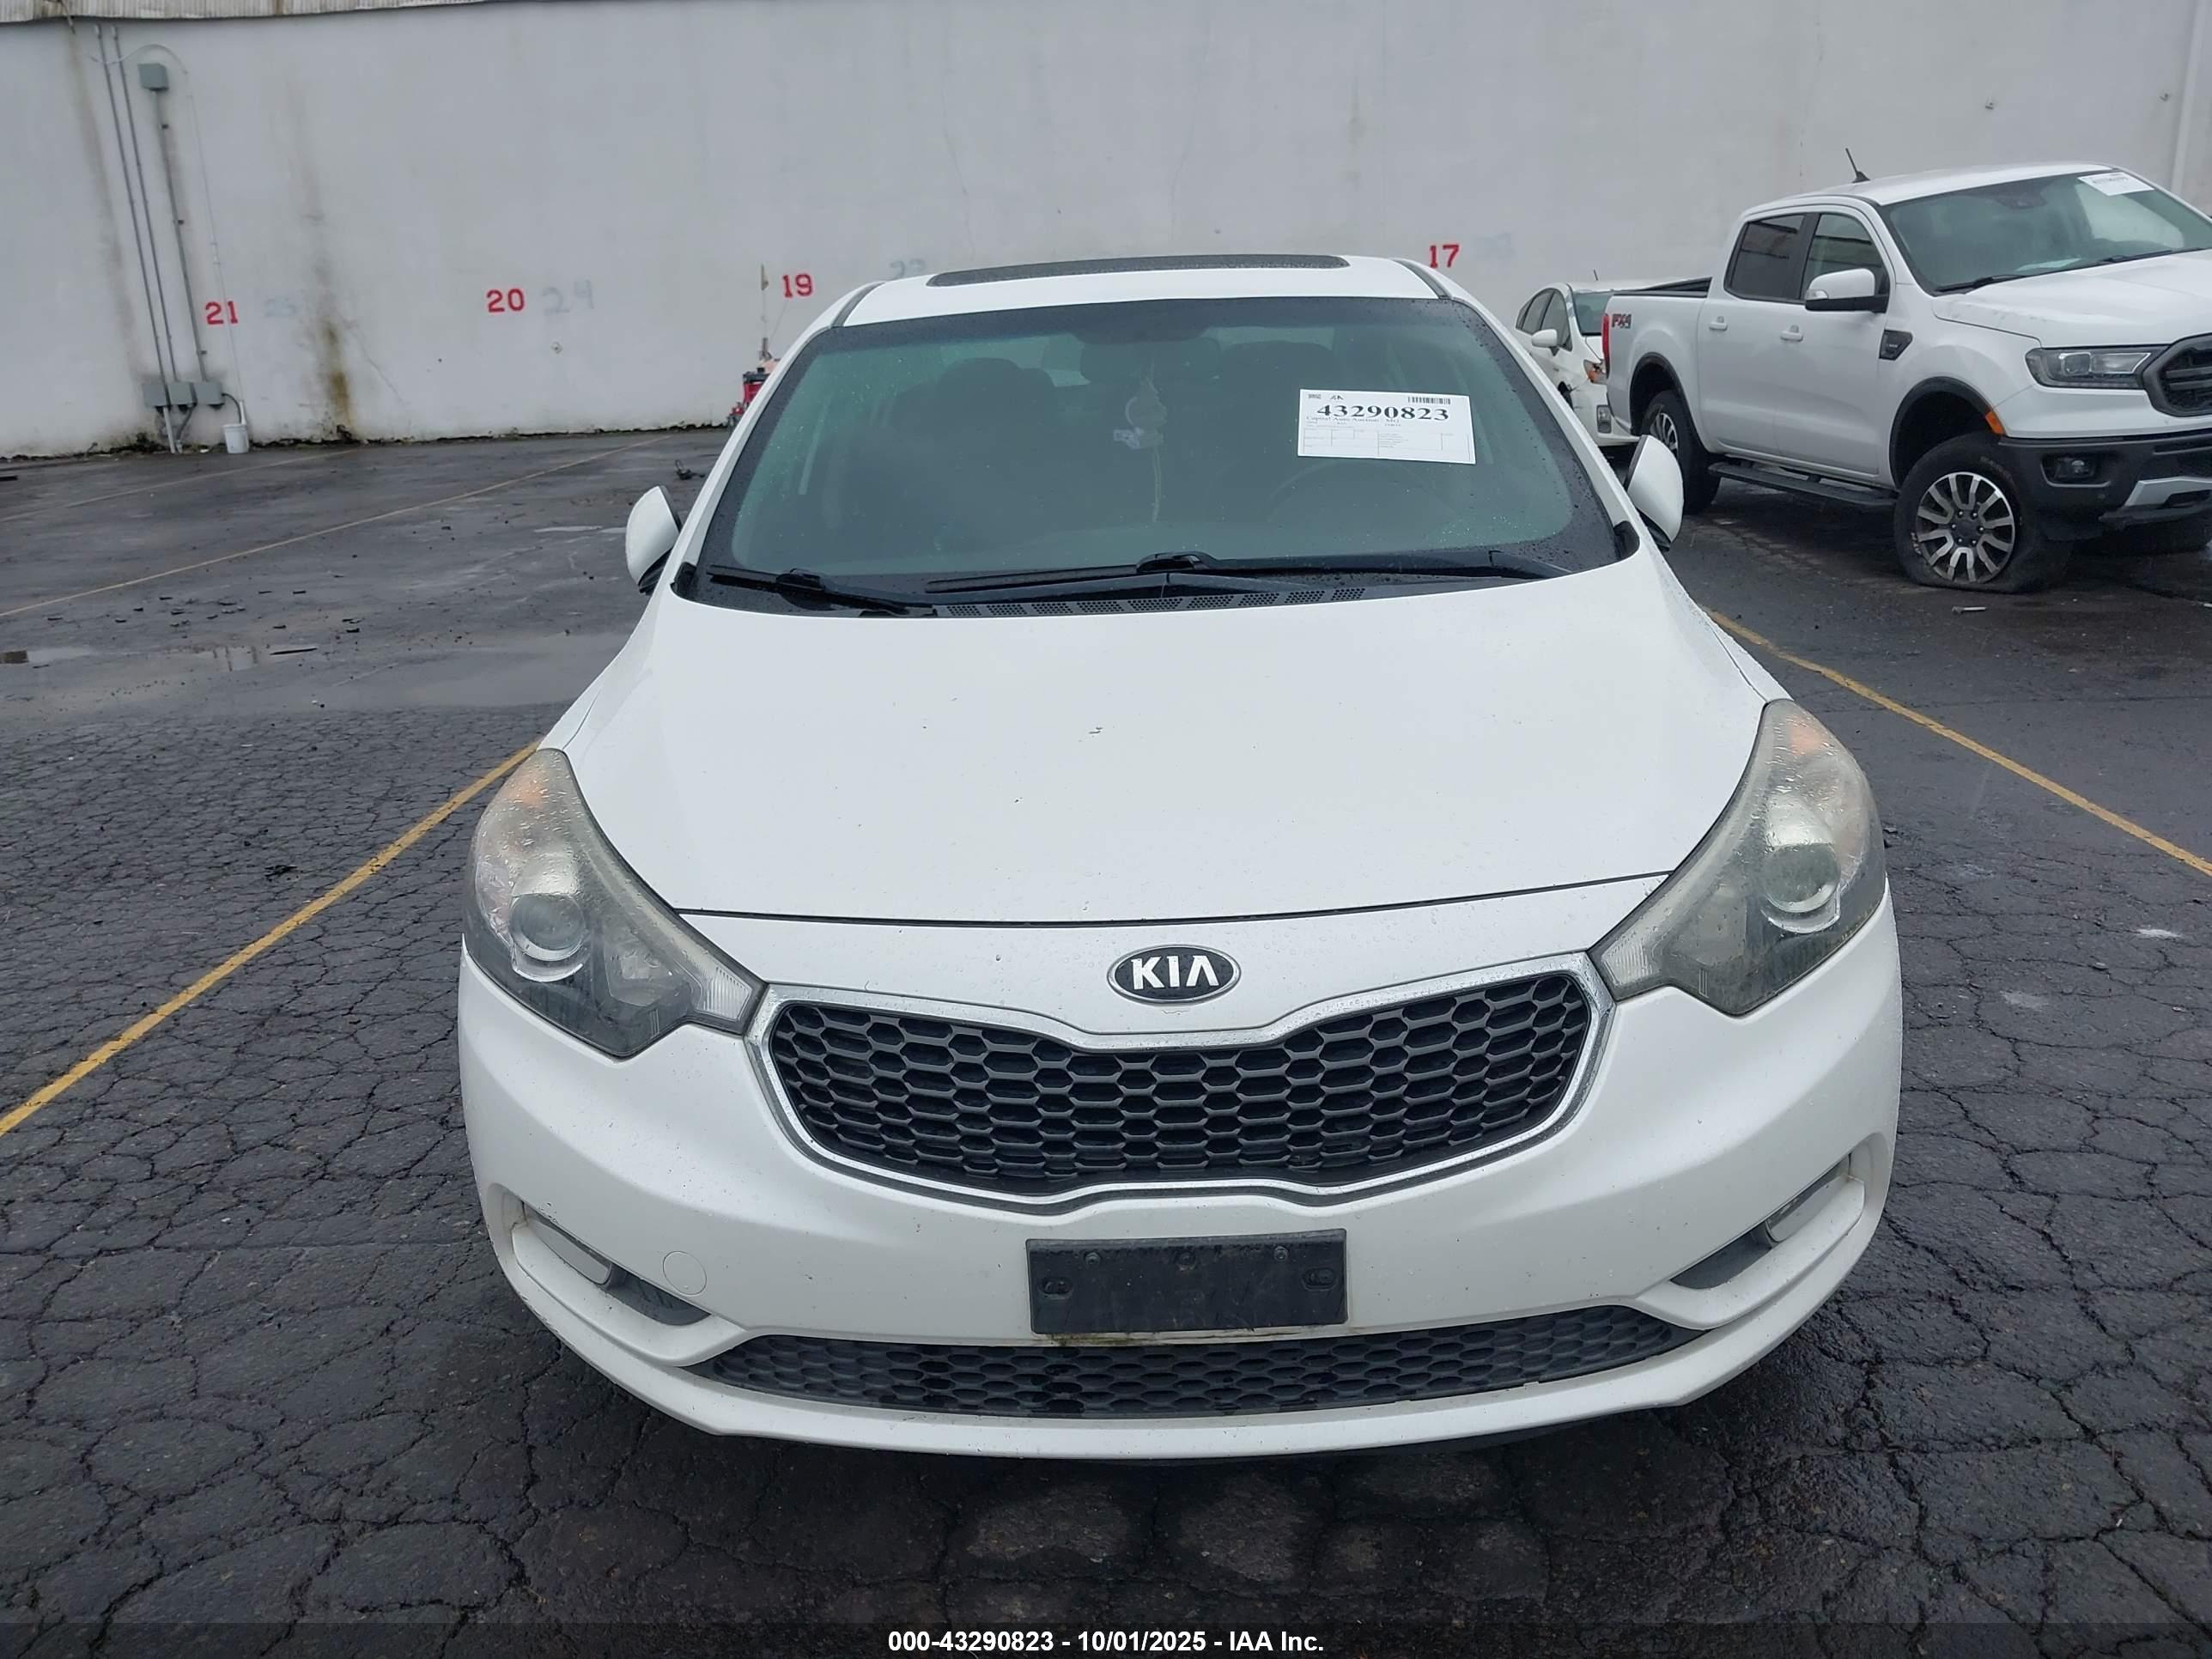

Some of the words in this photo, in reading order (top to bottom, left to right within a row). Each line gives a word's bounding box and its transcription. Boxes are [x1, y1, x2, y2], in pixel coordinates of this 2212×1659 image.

[1429, 244, 1460, 268] 17
[781, 273, 813, 298] 19
[485, 288, 526, 313] 20
[204, 301, 239, 325] 21
[1316, 404, 1449, 422] 43290823
[1131, 954, 1220, 991] KIA
